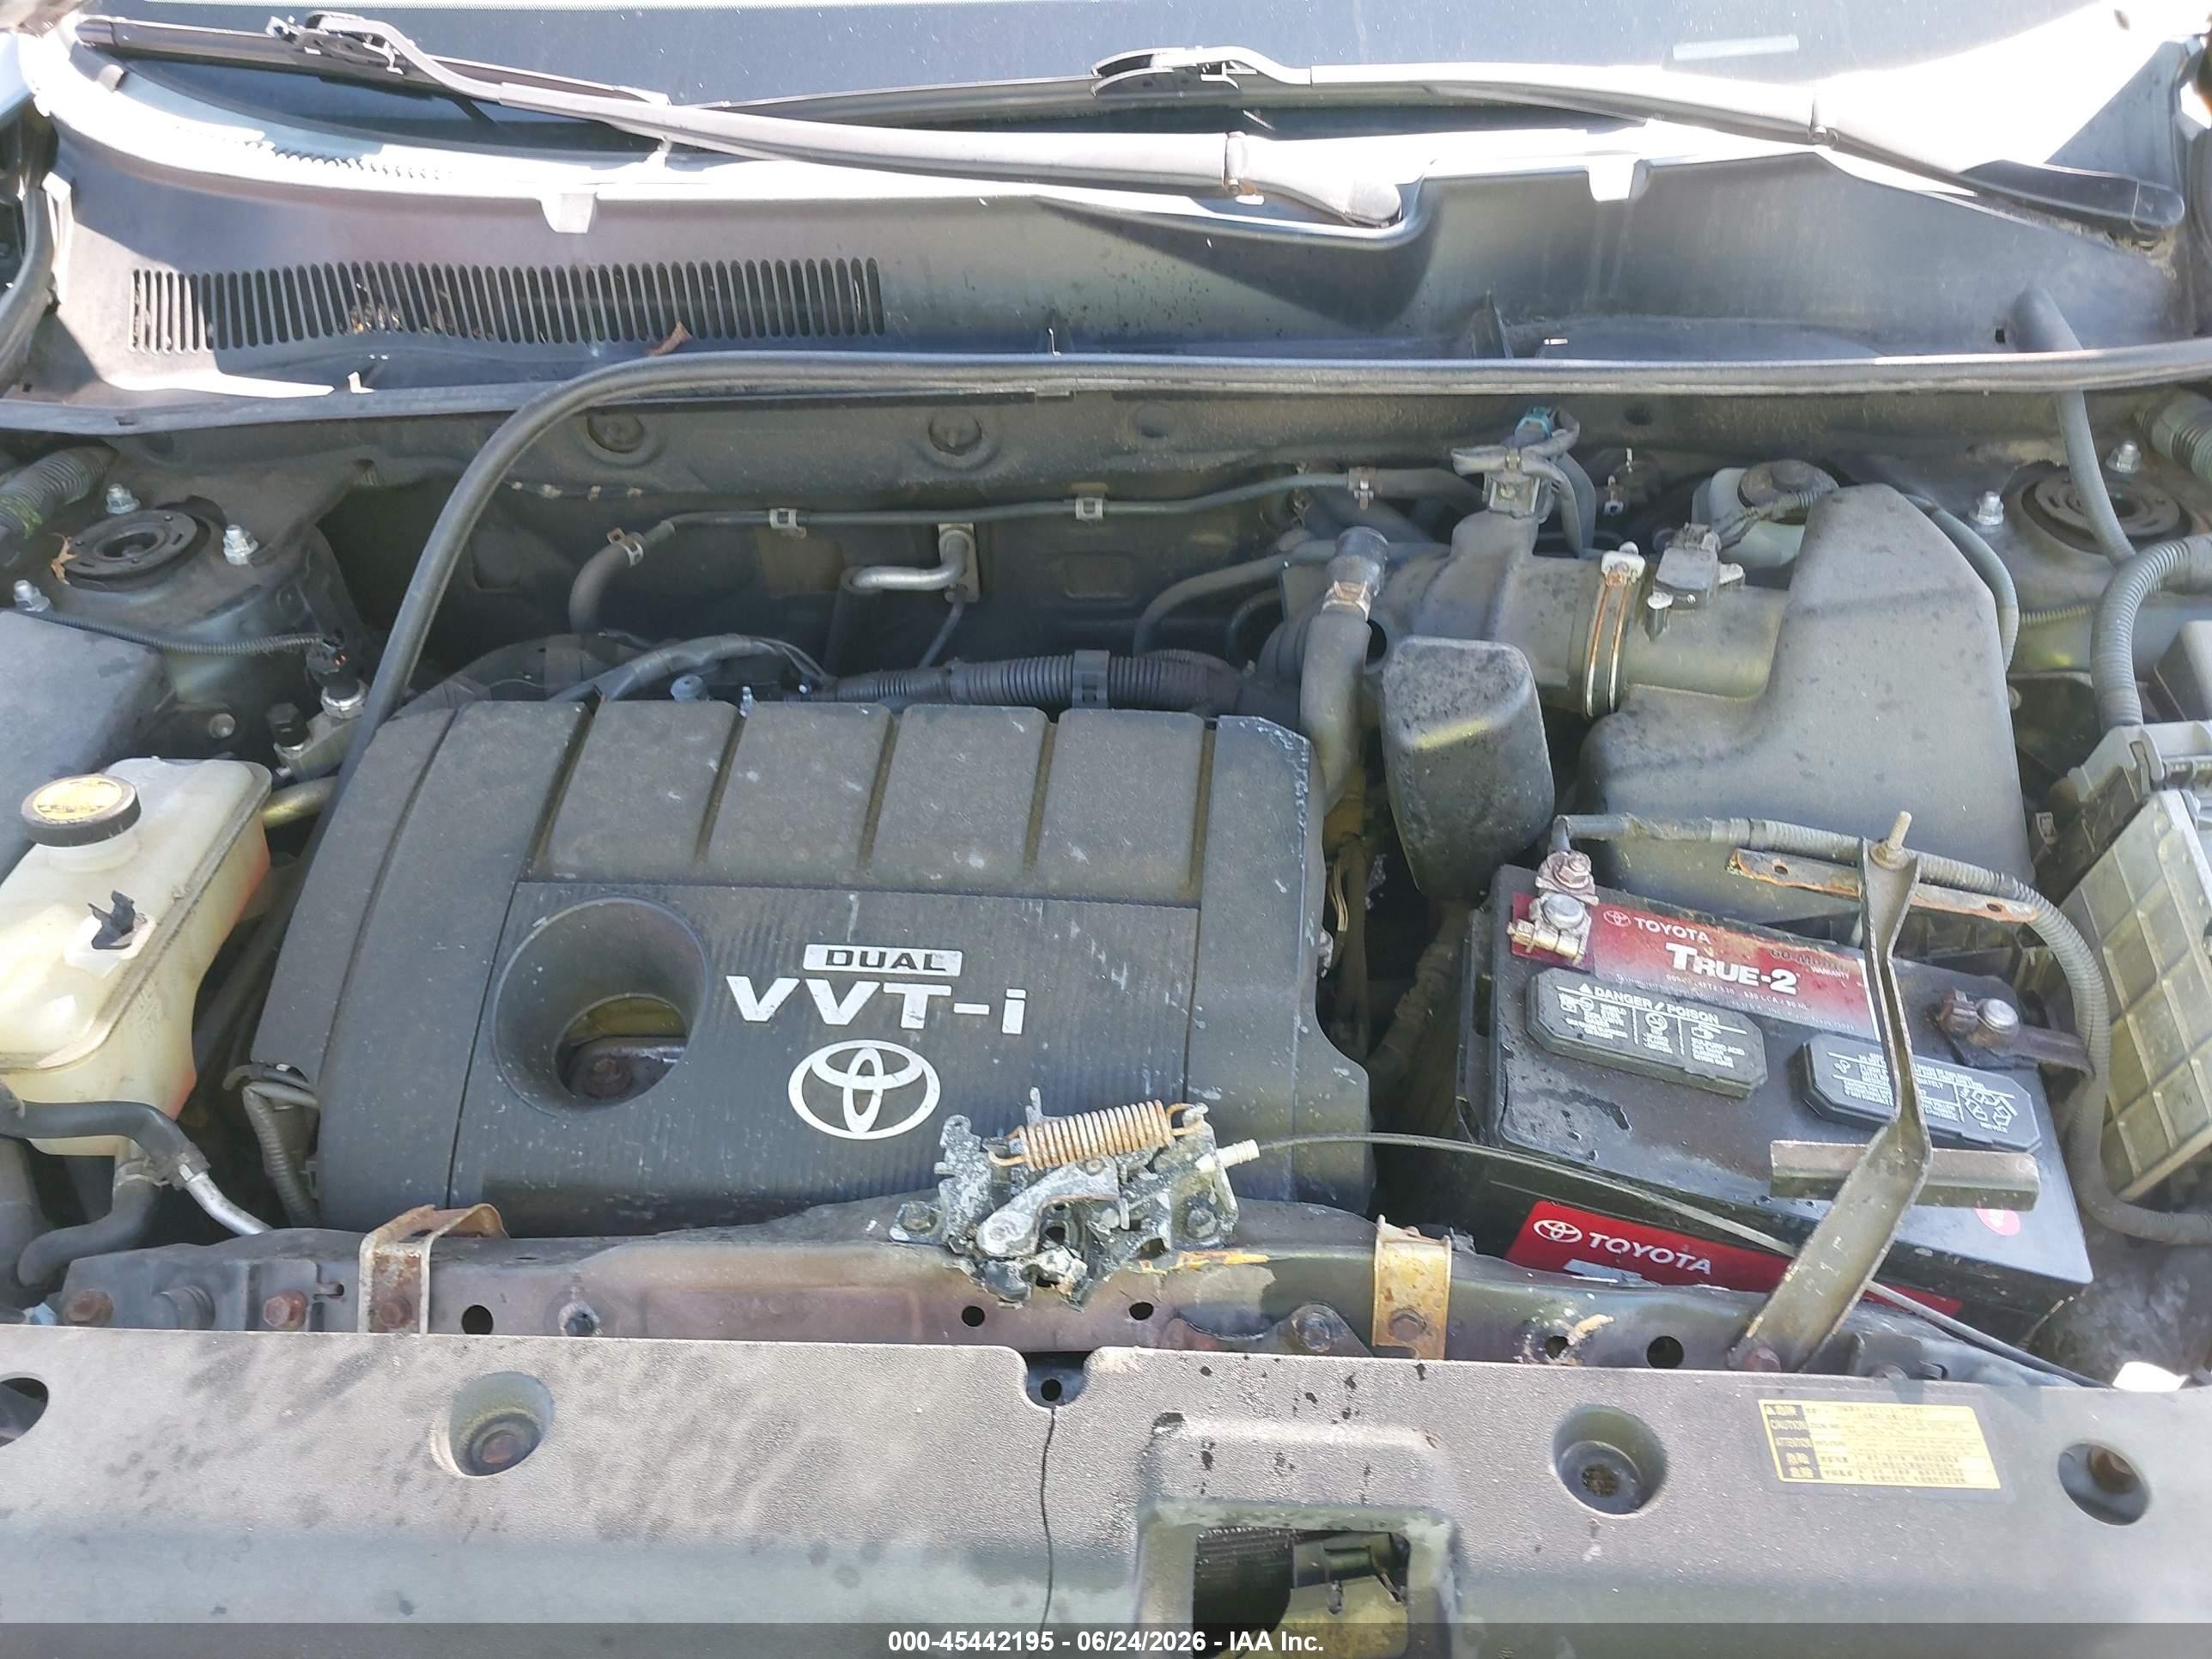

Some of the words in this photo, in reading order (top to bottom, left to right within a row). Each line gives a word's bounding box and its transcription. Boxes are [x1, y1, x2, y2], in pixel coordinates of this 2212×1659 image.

[1634, 917, 1711, 945] TOYOTA
[825, 950, 947, 972] DUAL
[726, 975, 1027, 1035] VVT-i
[1594, 986, 1653, 1010] DANGER
[1666, 1004, 1719, 1024] POISON
[1589, 1232, 1711, 1275] TOYOTA
[1769, 1419, 1808, 1431] CAUTION
